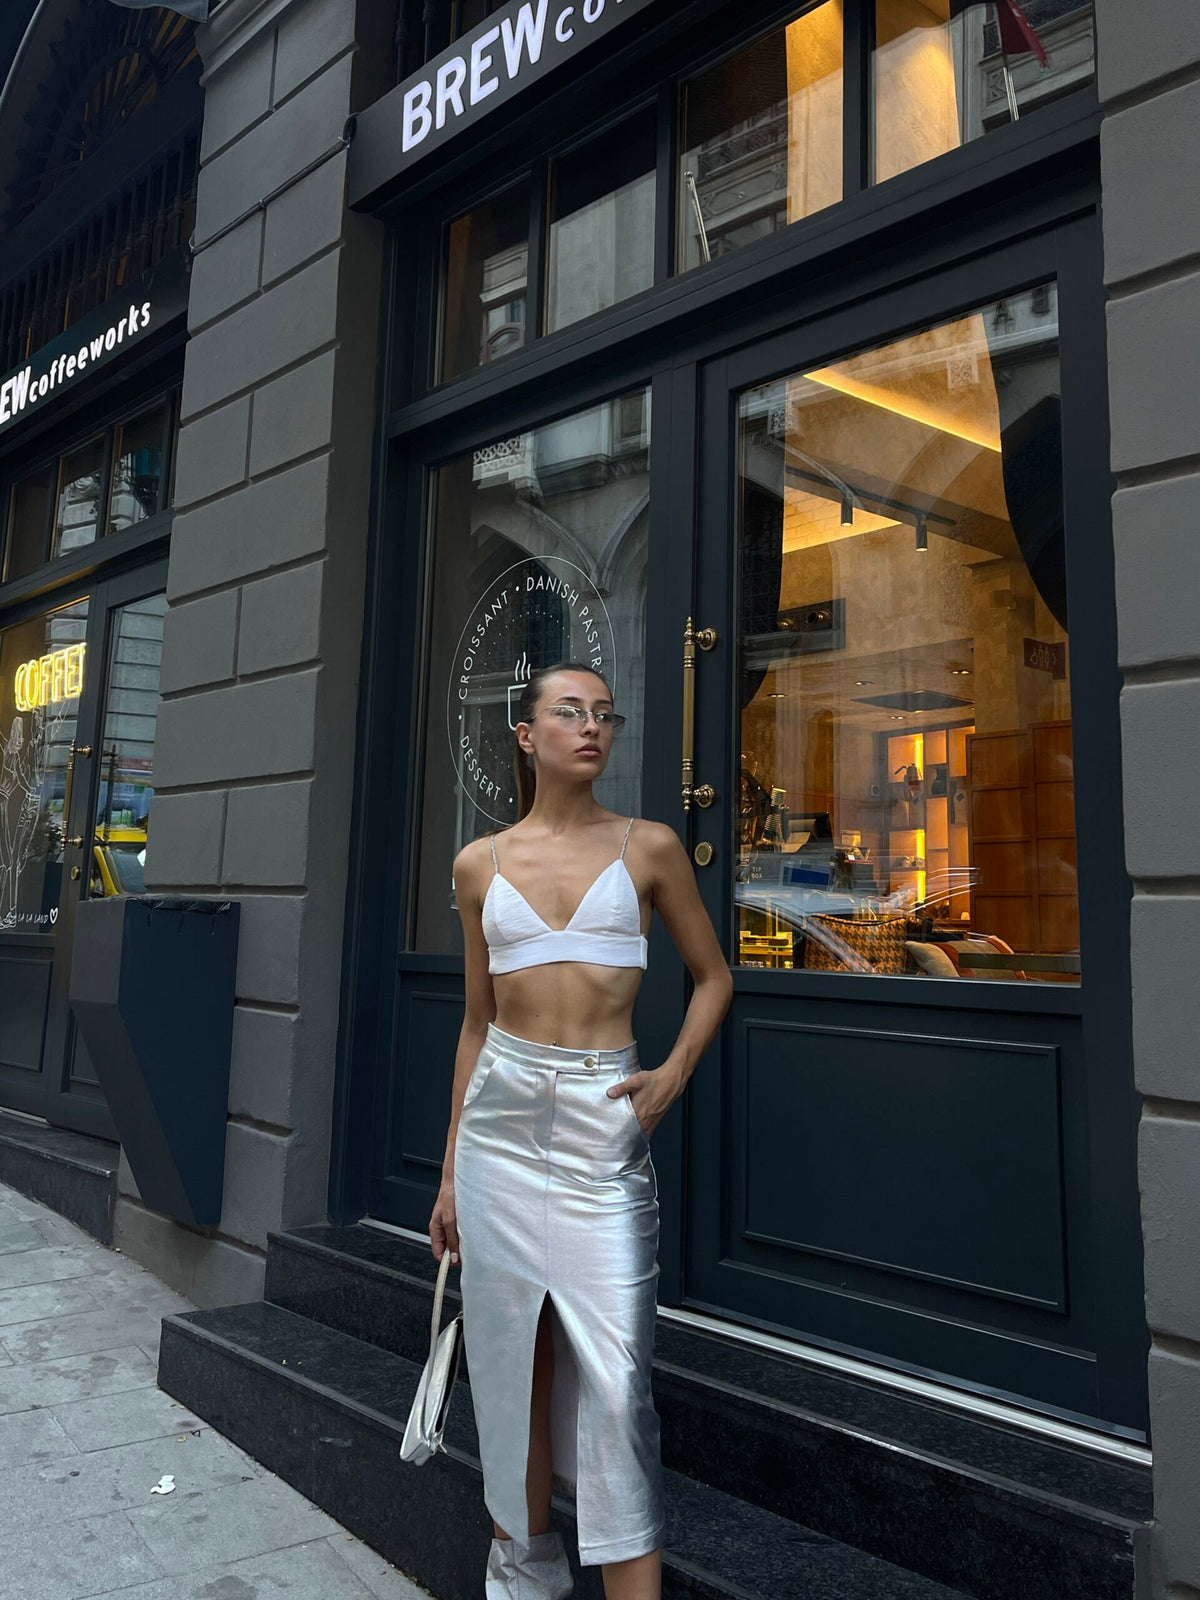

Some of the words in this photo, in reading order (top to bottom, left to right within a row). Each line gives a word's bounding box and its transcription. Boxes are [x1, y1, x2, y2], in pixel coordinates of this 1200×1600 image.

[458, 590, 508, 700] CROISSANT
[526, 575, 580, 607] DANISH
[578, 605, 603, 674] PASTR
[14, 642, 87, 712] COFFE
[460, 735, 502, 801] DESSERT
